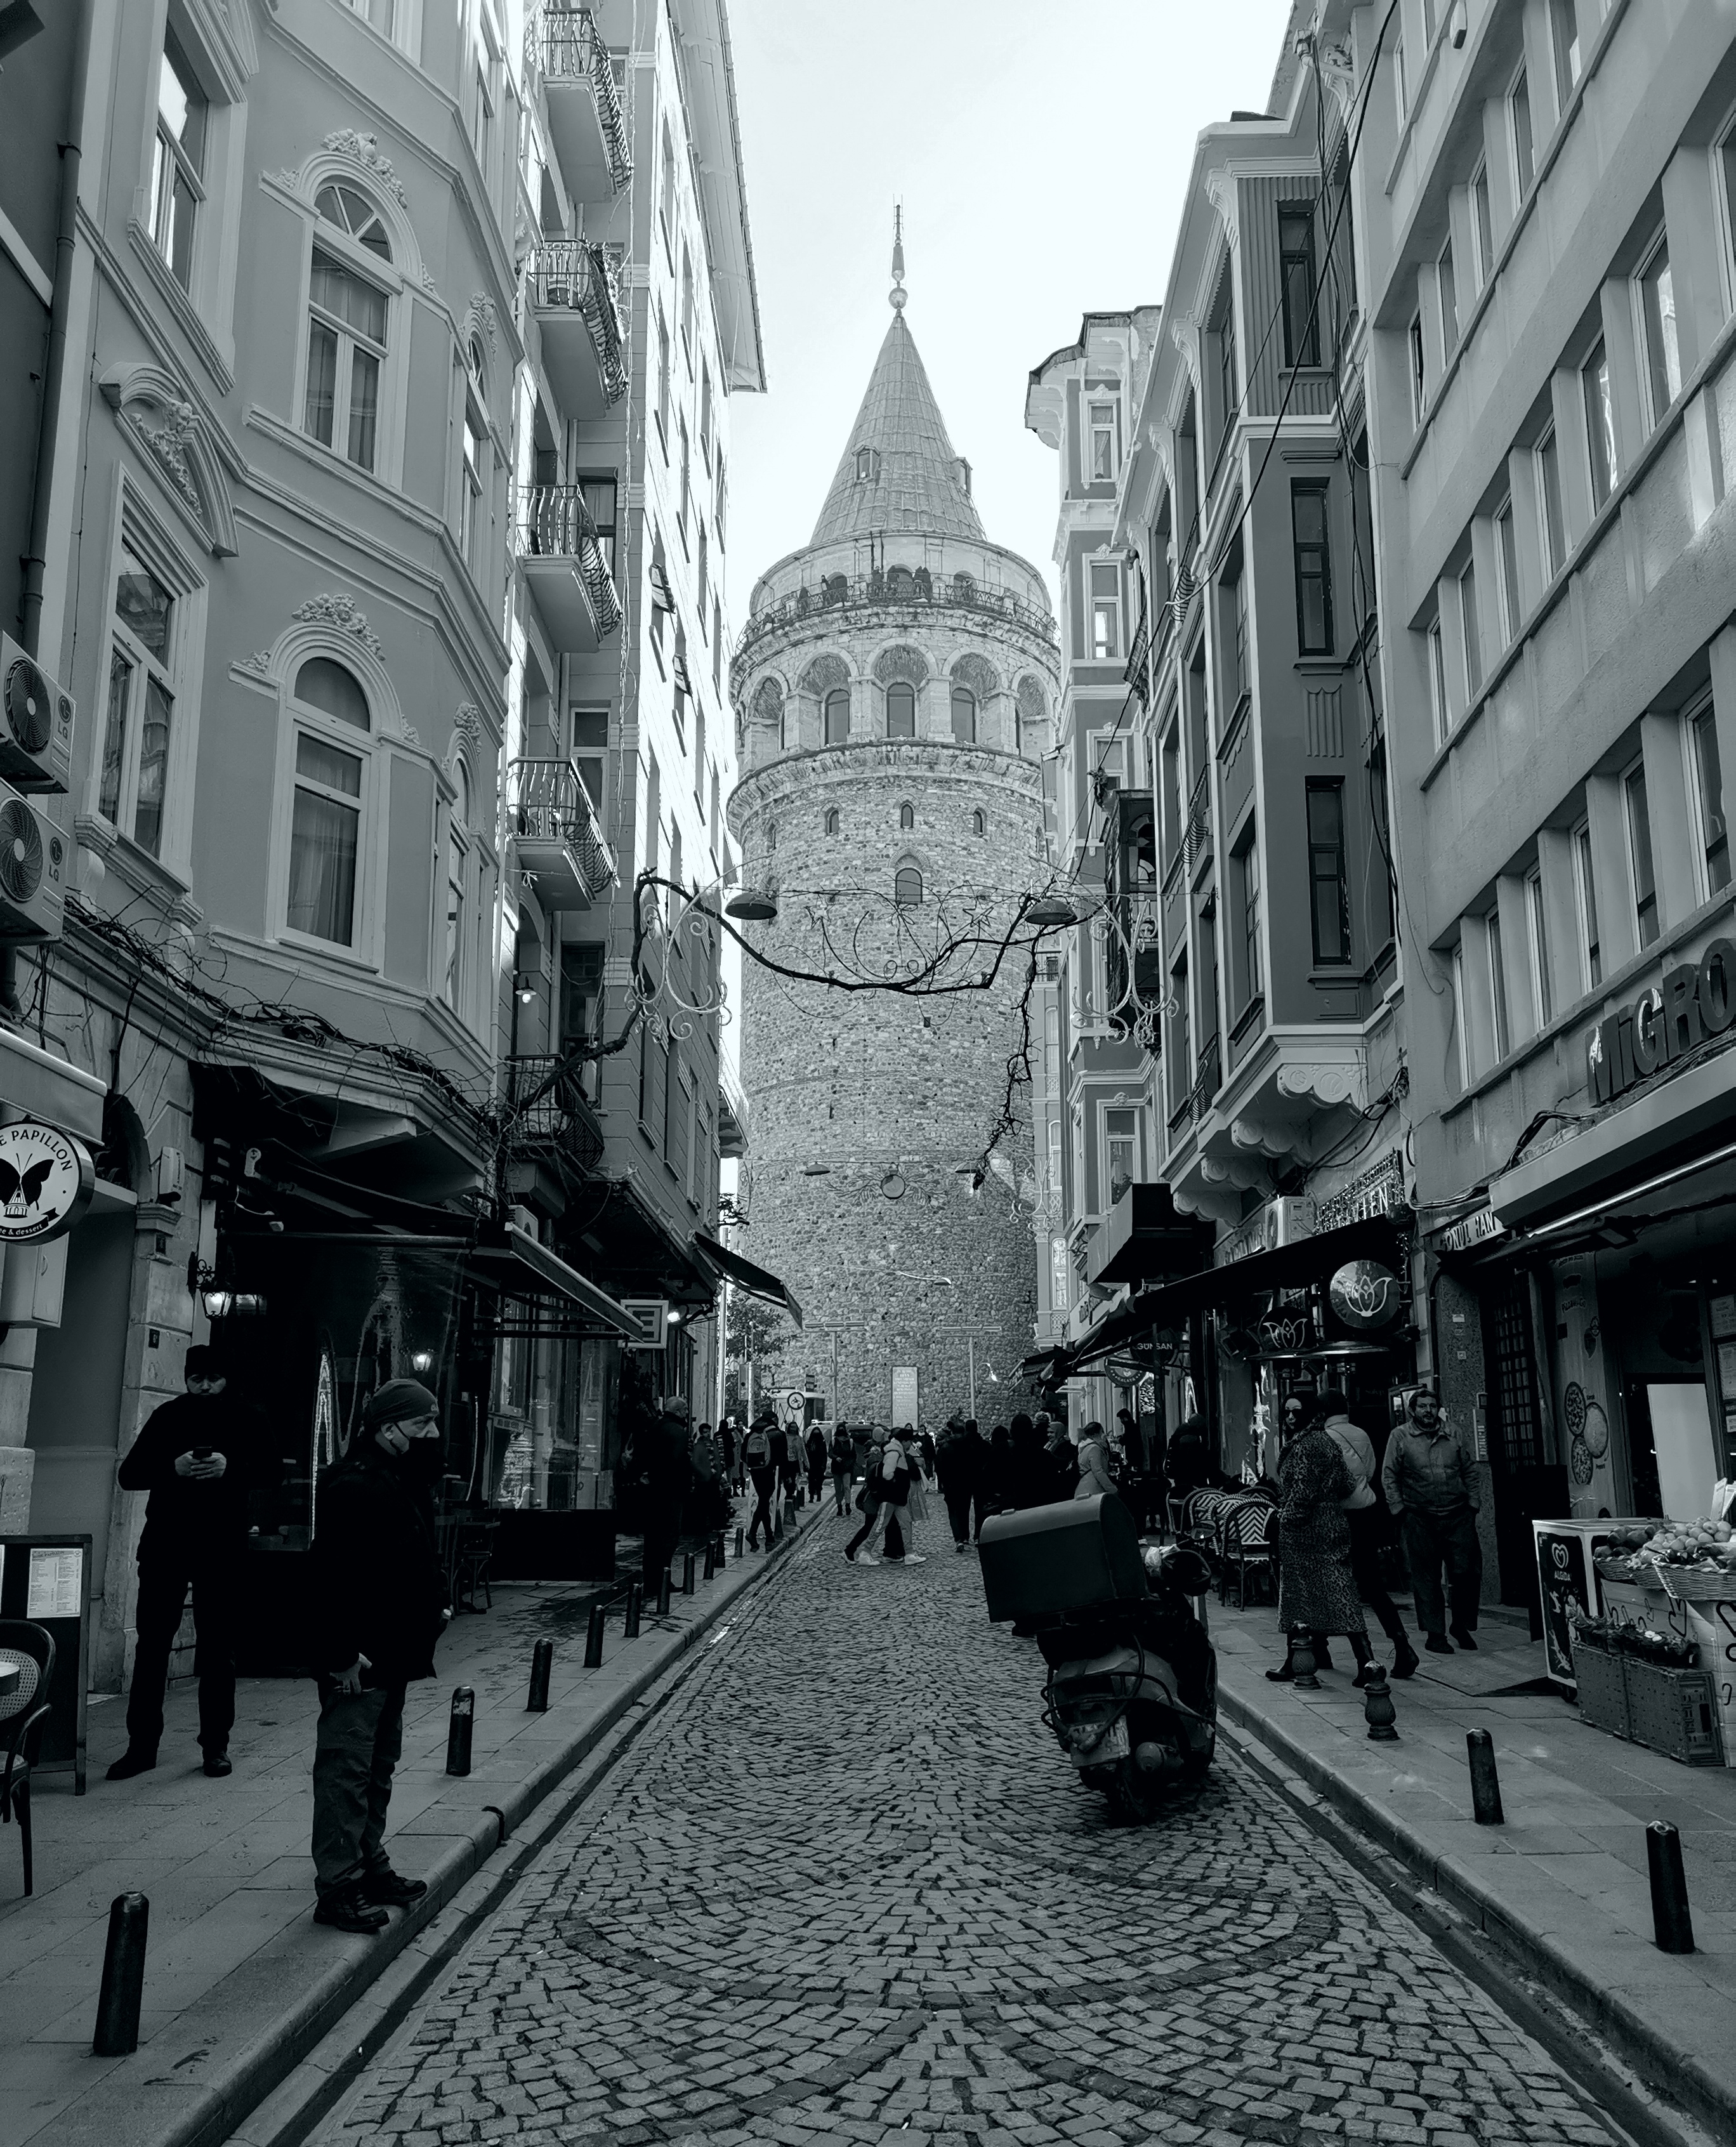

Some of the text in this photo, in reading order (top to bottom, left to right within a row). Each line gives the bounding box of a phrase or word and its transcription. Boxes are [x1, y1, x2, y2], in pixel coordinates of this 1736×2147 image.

[58, 721, 68, 740] LG
[49, 864, 60, 883] LG
[11, 1129, 73, 1171] PAPILLON
[15, 1224, 43, 1235] dessert
